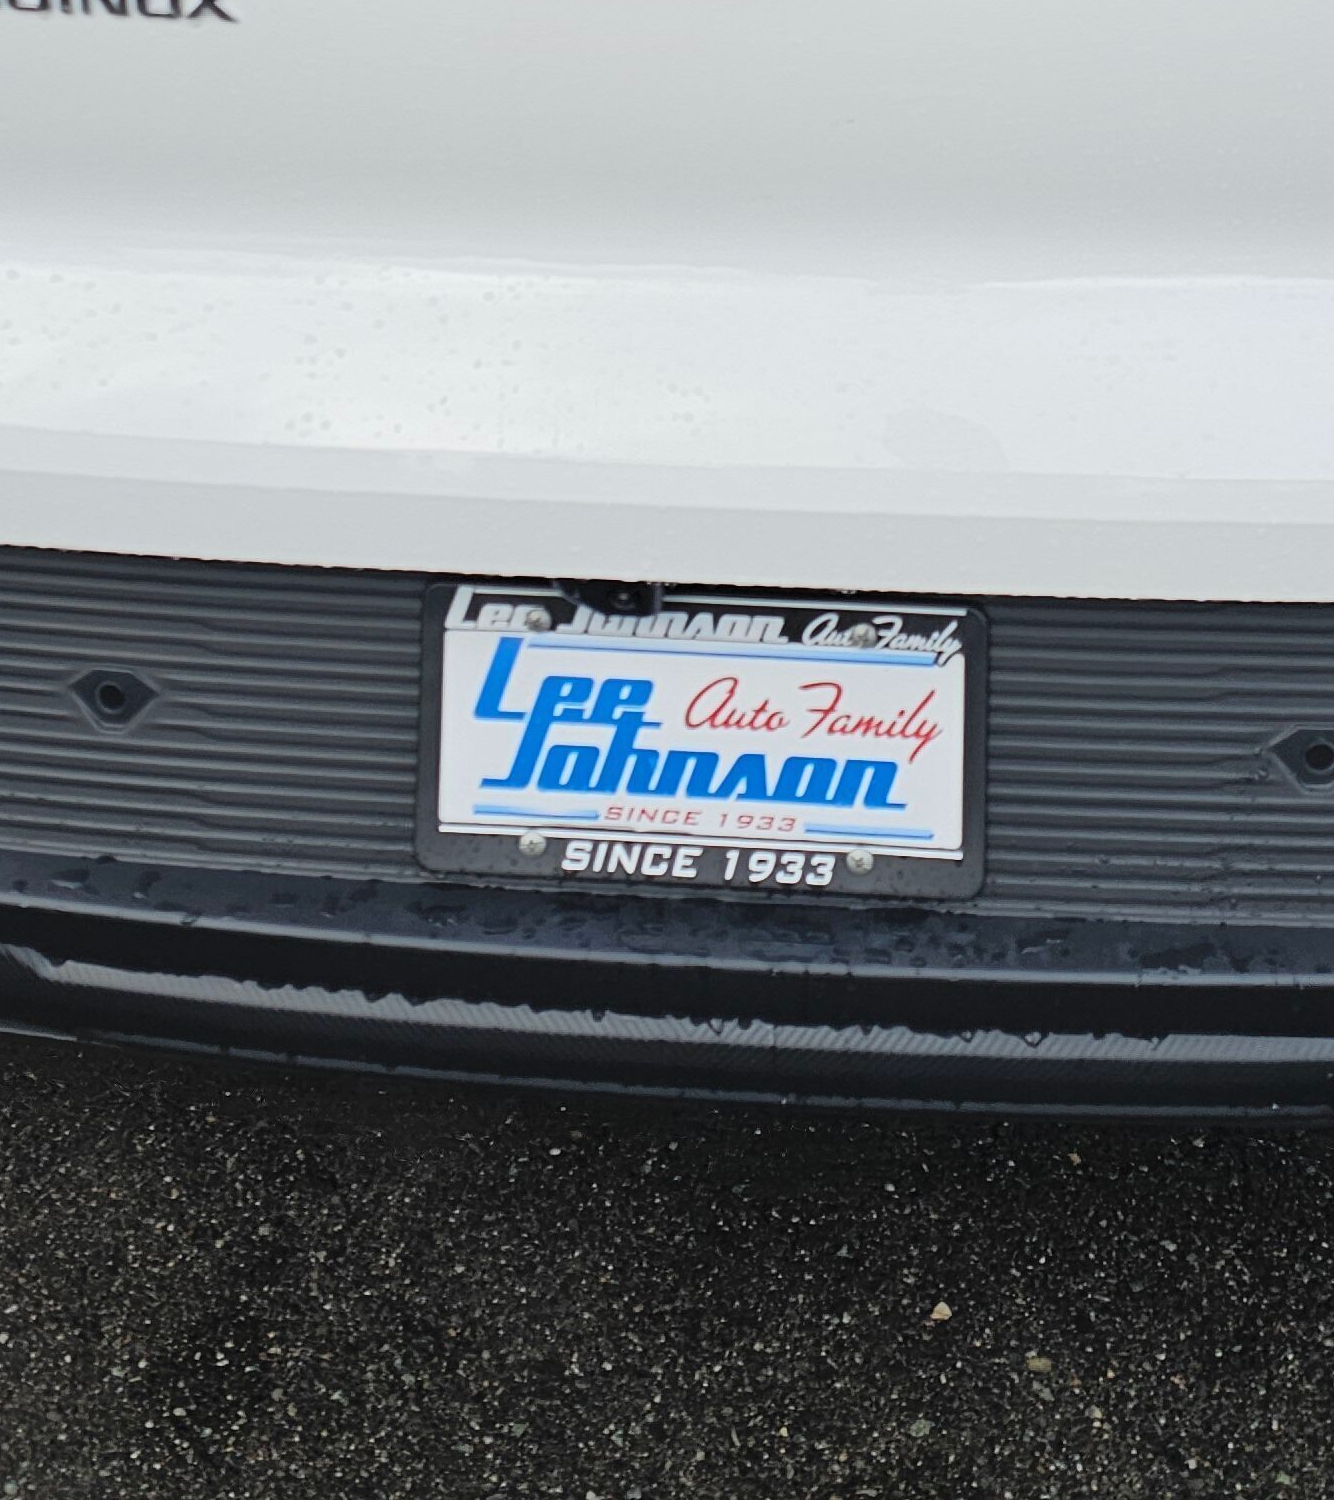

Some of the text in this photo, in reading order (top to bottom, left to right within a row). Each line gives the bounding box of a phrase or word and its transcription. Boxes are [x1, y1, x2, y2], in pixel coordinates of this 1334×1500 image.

[872, 615, 963, 667] Family
[474, 637, 661, 726] Lee
[684, 676, 944, 764] Auto Family
[480, 711, 908, 811] Johnson
[604, 806, 798, 833] SINCE 1933
[561, 839, 836, 887] SINCE 1933
